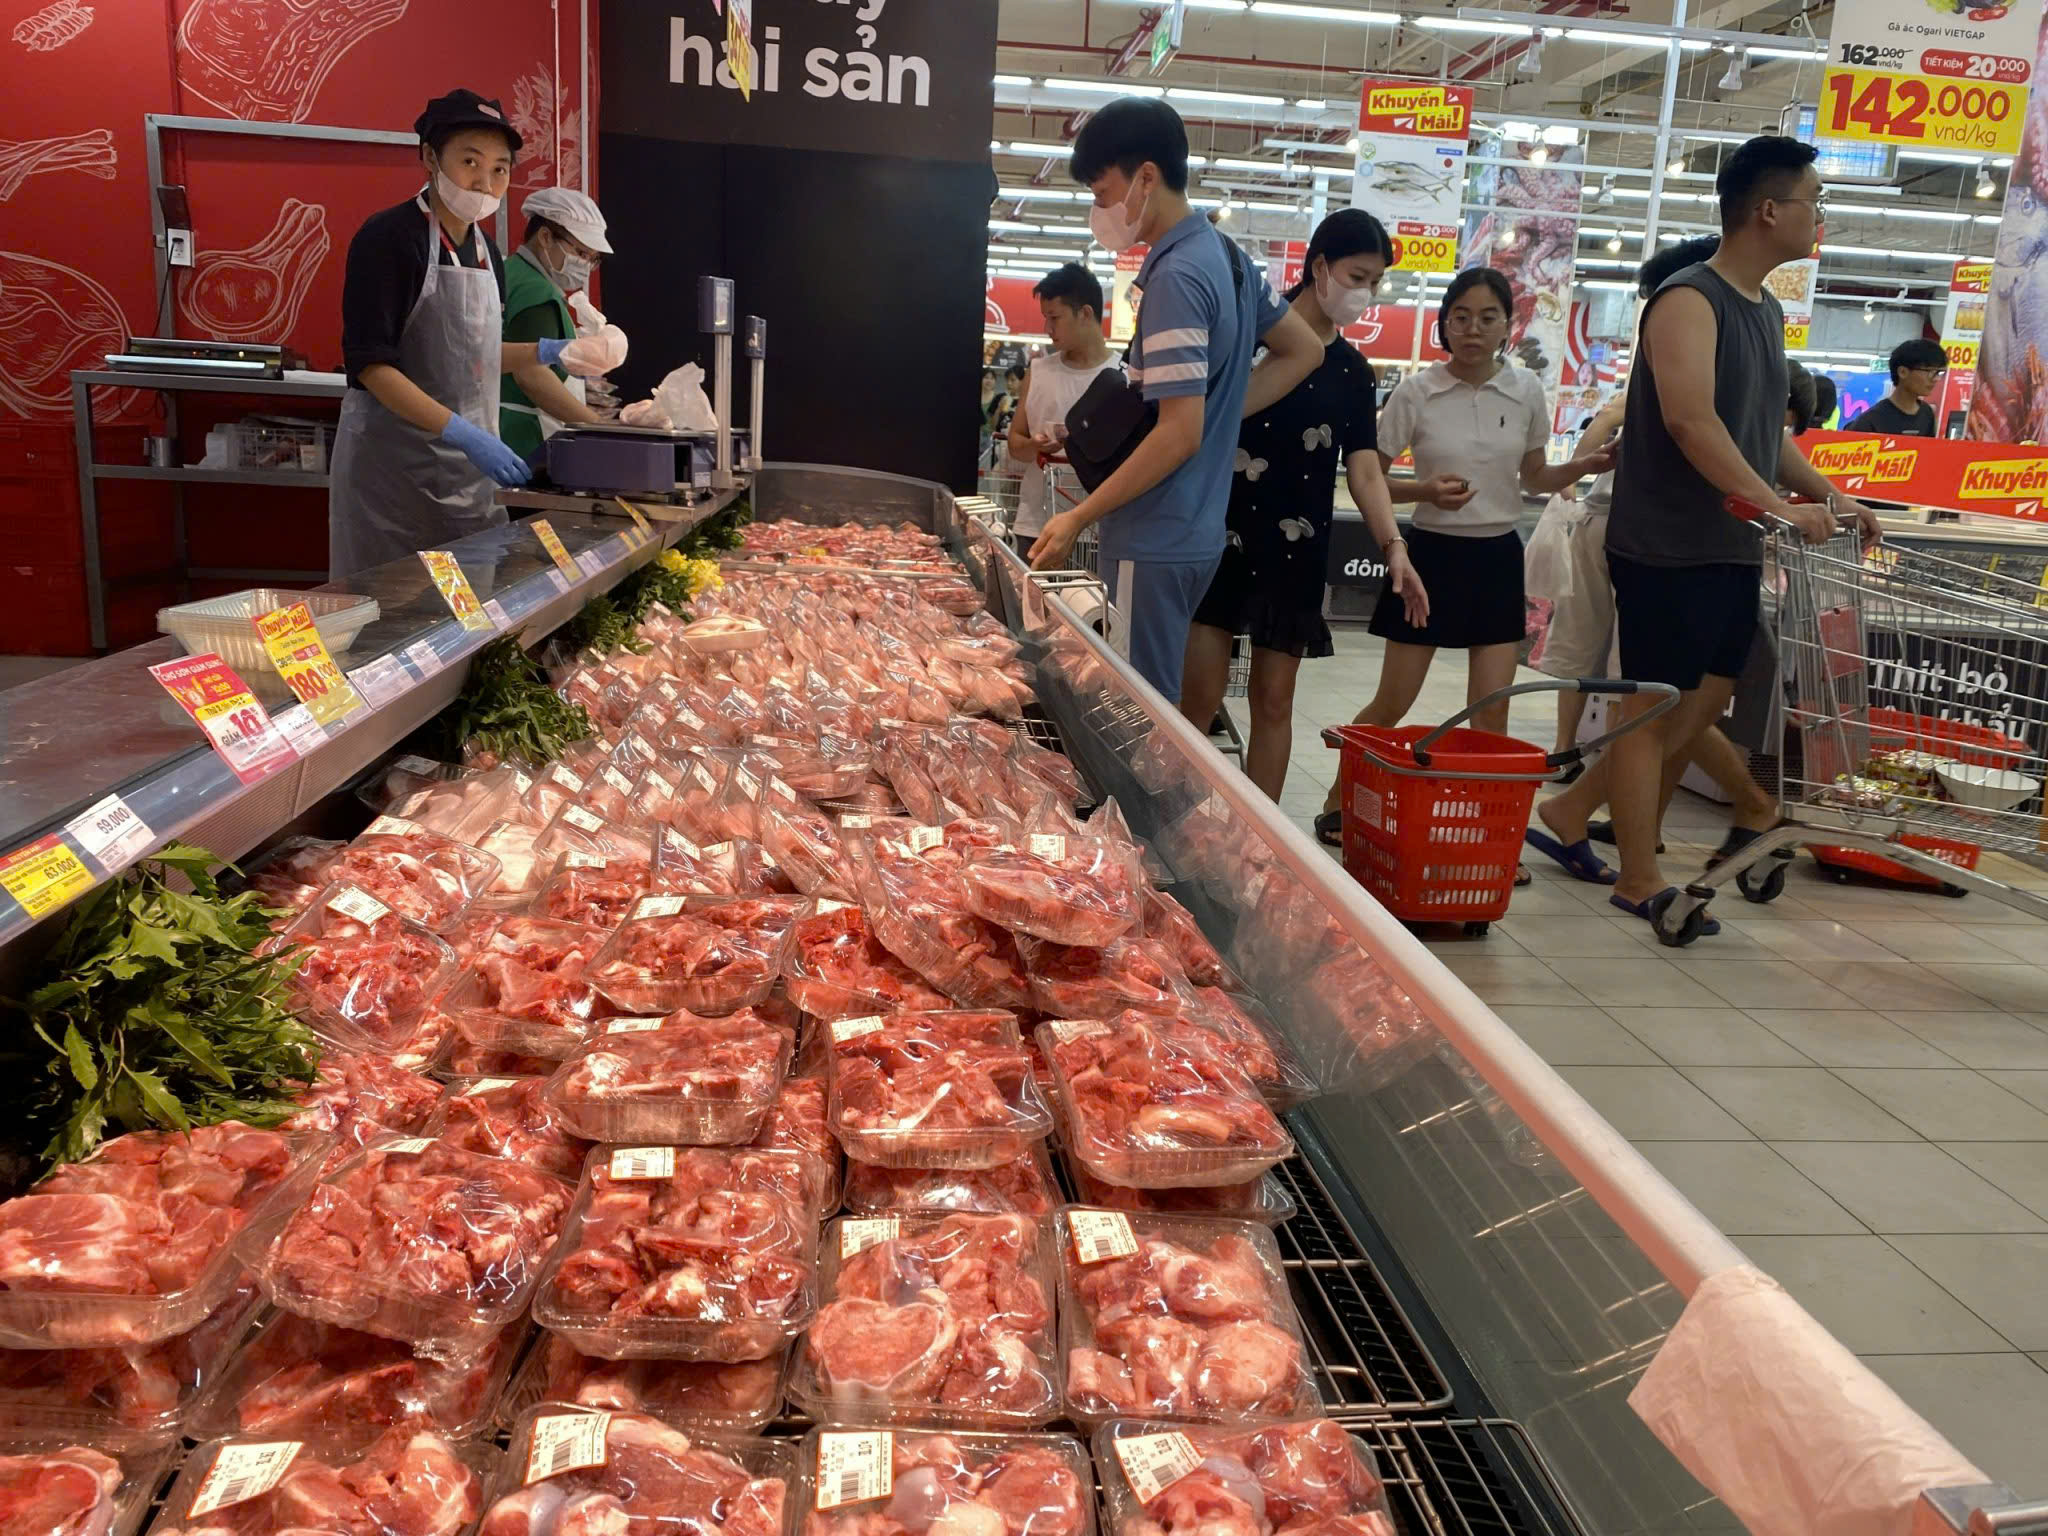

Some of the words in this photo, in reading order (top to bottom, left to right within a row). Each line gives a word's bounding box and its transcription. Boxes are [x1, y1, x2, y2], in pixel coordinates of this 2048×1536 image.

[1888, 22, 1901, 32] Gà
[1902, 23, 1914, 33] ác
[1916, 25, 1942, 37] Ogari
[1944, 28, 1985, 41] VIETGAP
[802, 24, 931, 107] sản
[1878, 58, 1903, 70] vnd/kg
[1924, 55, 1942, 67] TIẾT
[1943, 58, 1964, 70] KIỆM
[1965, 55, 2026, 79] 20.000
[1371, 90, 1440, 111] Khuyến
[1830, 73, 2011, 138] 142.000
[1420, 106, 1461, 130] Mãi!
[1934, 123, 1997, 147] vnd/kg
[1811, 443, 1873, 471] Khuyến
[1872, 454, 1912, 479] Mãi!
[1964, 461, 2048, 494] Khuyến
[1344, 558, 1389, 578] đôn
[1956, 661, 2009, 696] bò
